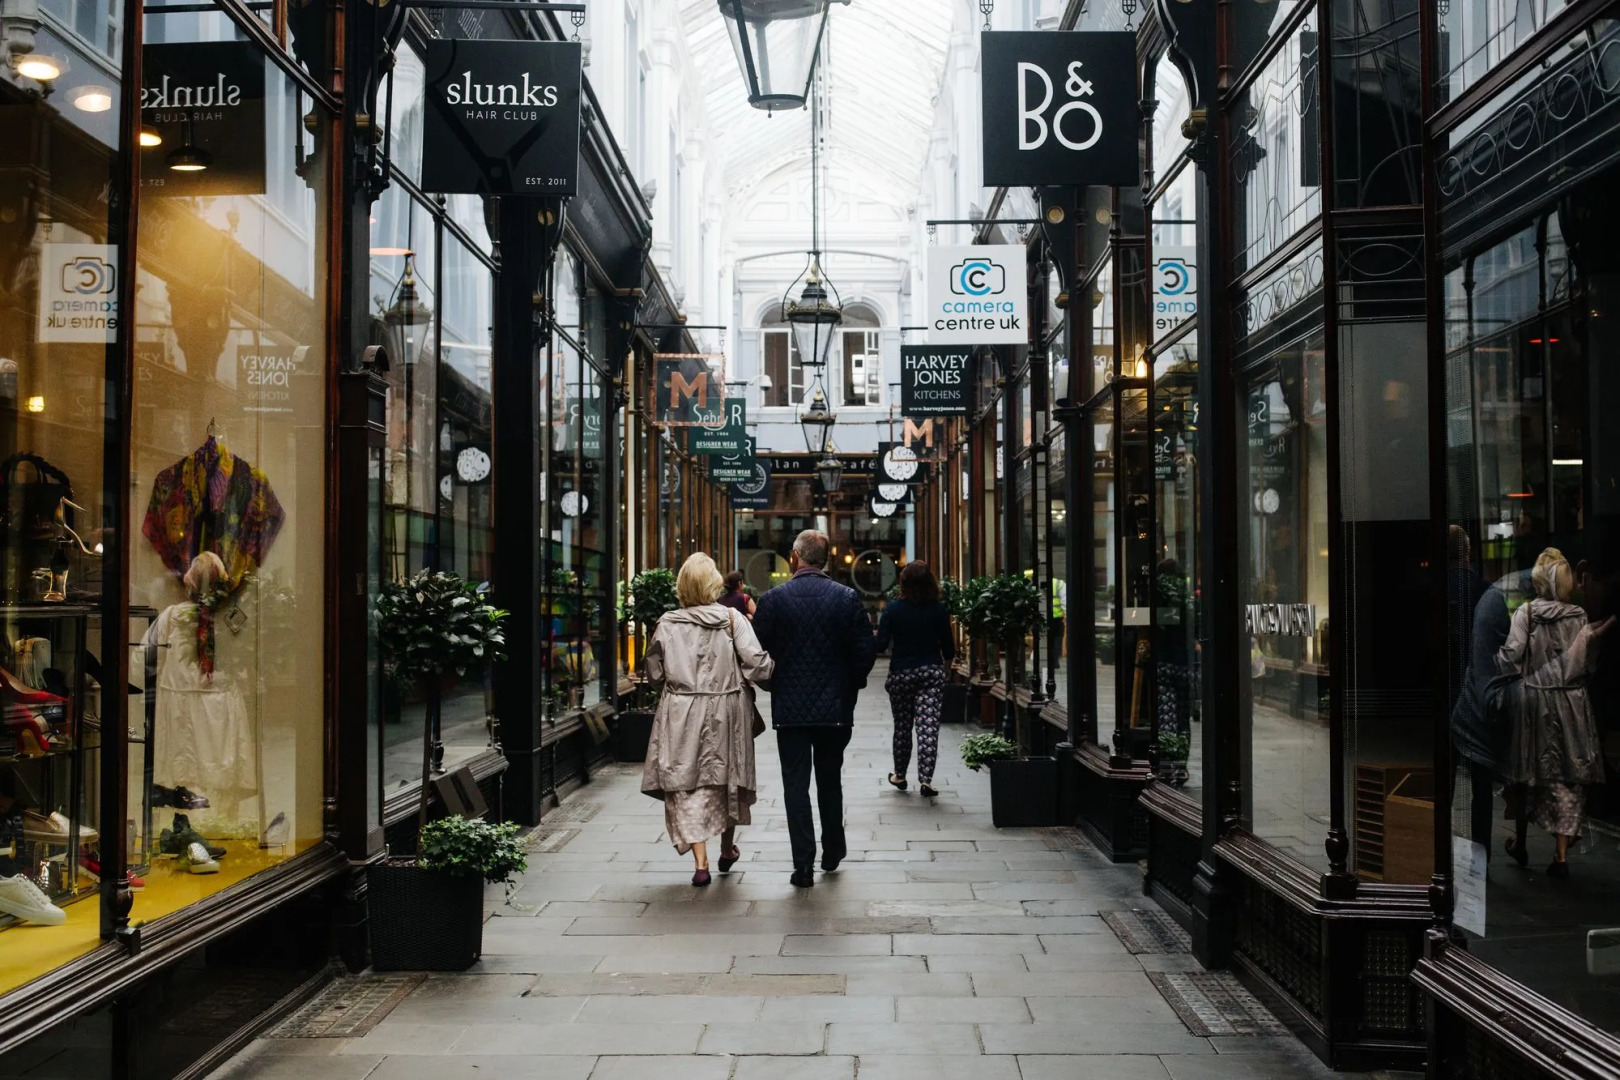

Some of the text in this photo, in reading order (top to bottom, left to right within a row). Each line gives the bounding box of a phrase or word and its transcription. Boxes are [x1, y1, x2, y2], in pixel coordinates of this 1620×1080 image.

[447, 71, 558, 107] slunks
[1018, 61, 1103, 150] B&O
[466, 111, 537, 121] HAIR CLUB
[548, 178, 567, 186] 2011
[942, 301, 1014, 313] camera
[934, 315, 1020, 330] centre uk
[905, 355, 968, 369] HARVEY
[914, 370, 961, 387] JONES
[670, 371, 707, 408] M
[914, 390, 961, 399] KITCHENS
[731, 404, 742, 426] R
[903, 418, 933, 448] M
[770, 459, 799, 469] lan
